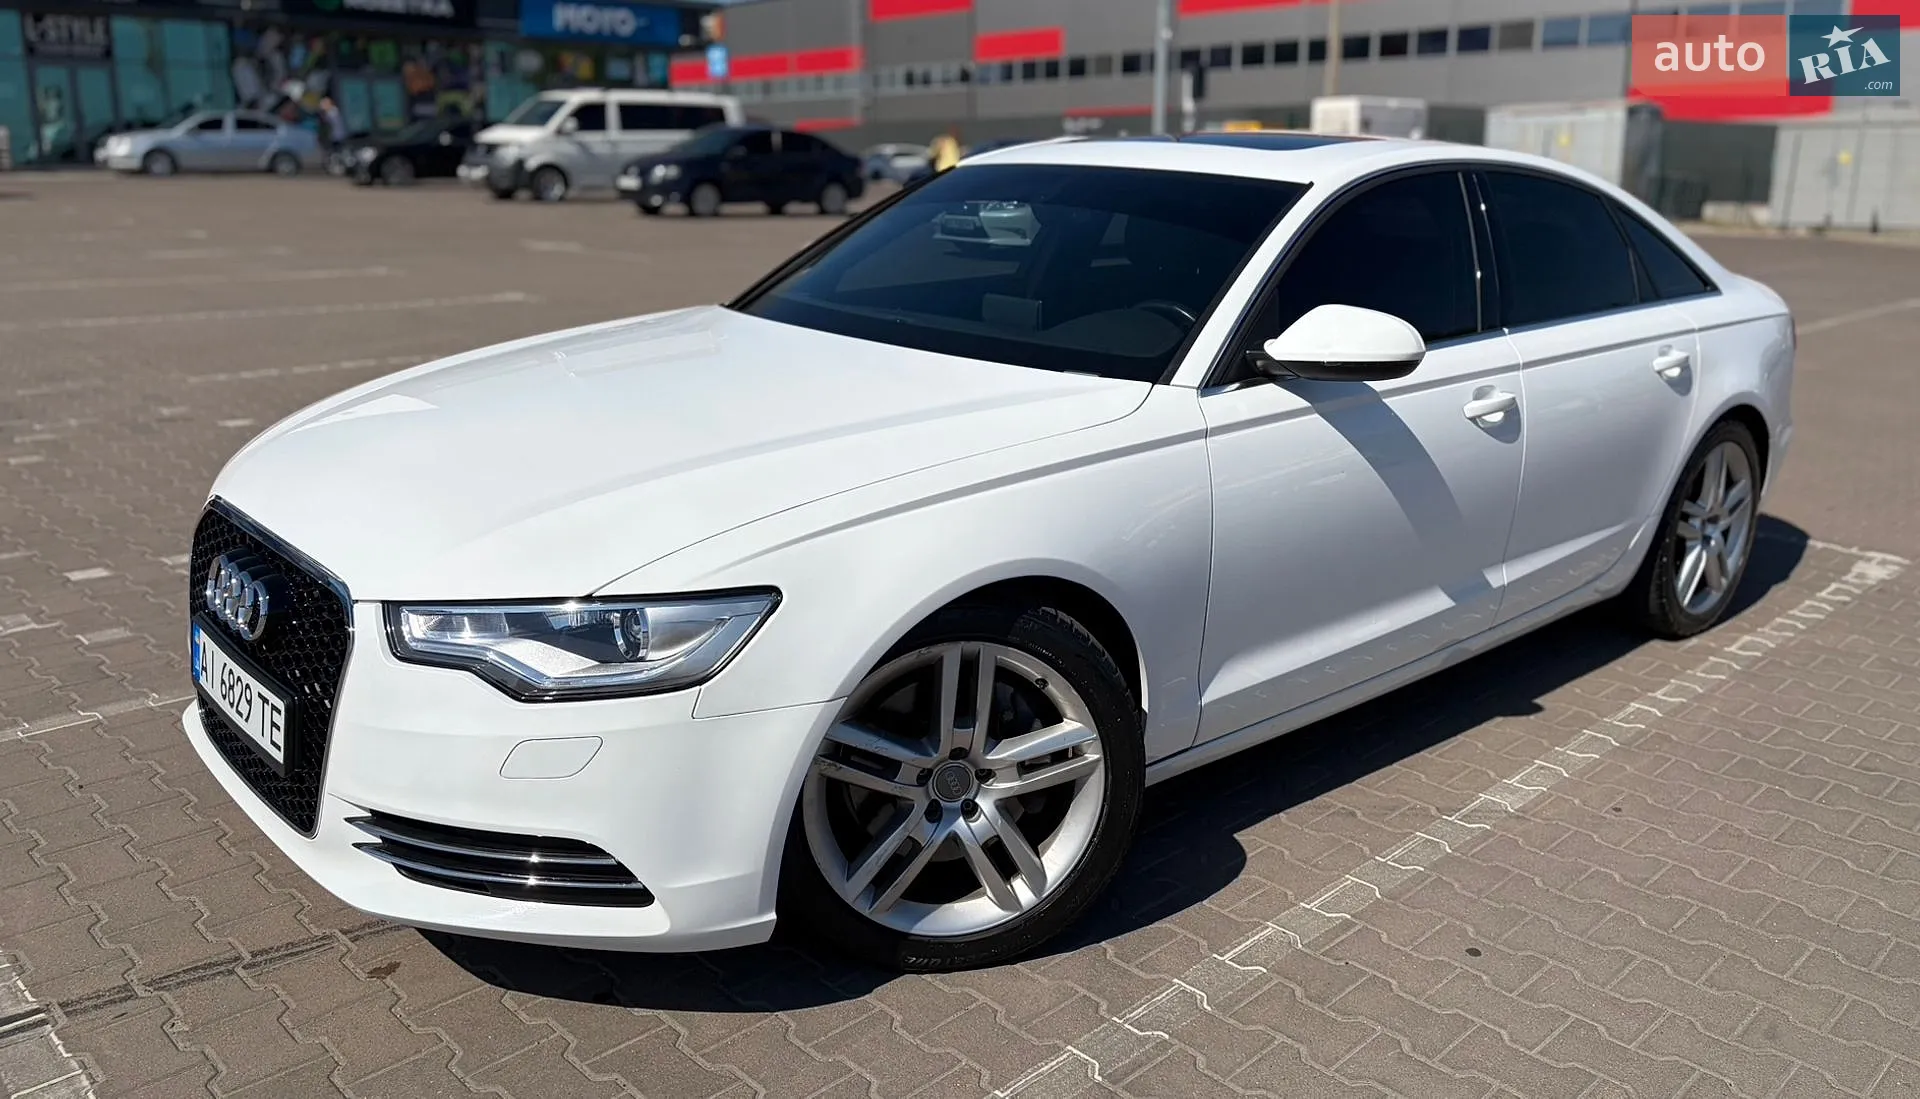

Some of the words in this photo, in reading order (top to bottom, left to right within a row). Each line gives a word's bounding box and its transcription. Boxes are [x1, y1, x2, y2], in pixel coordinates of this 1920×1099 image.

[201, 641, 214, 689] AI
[220, 662, 253, 724] 6829
[257, 691, 282, 753] TE
